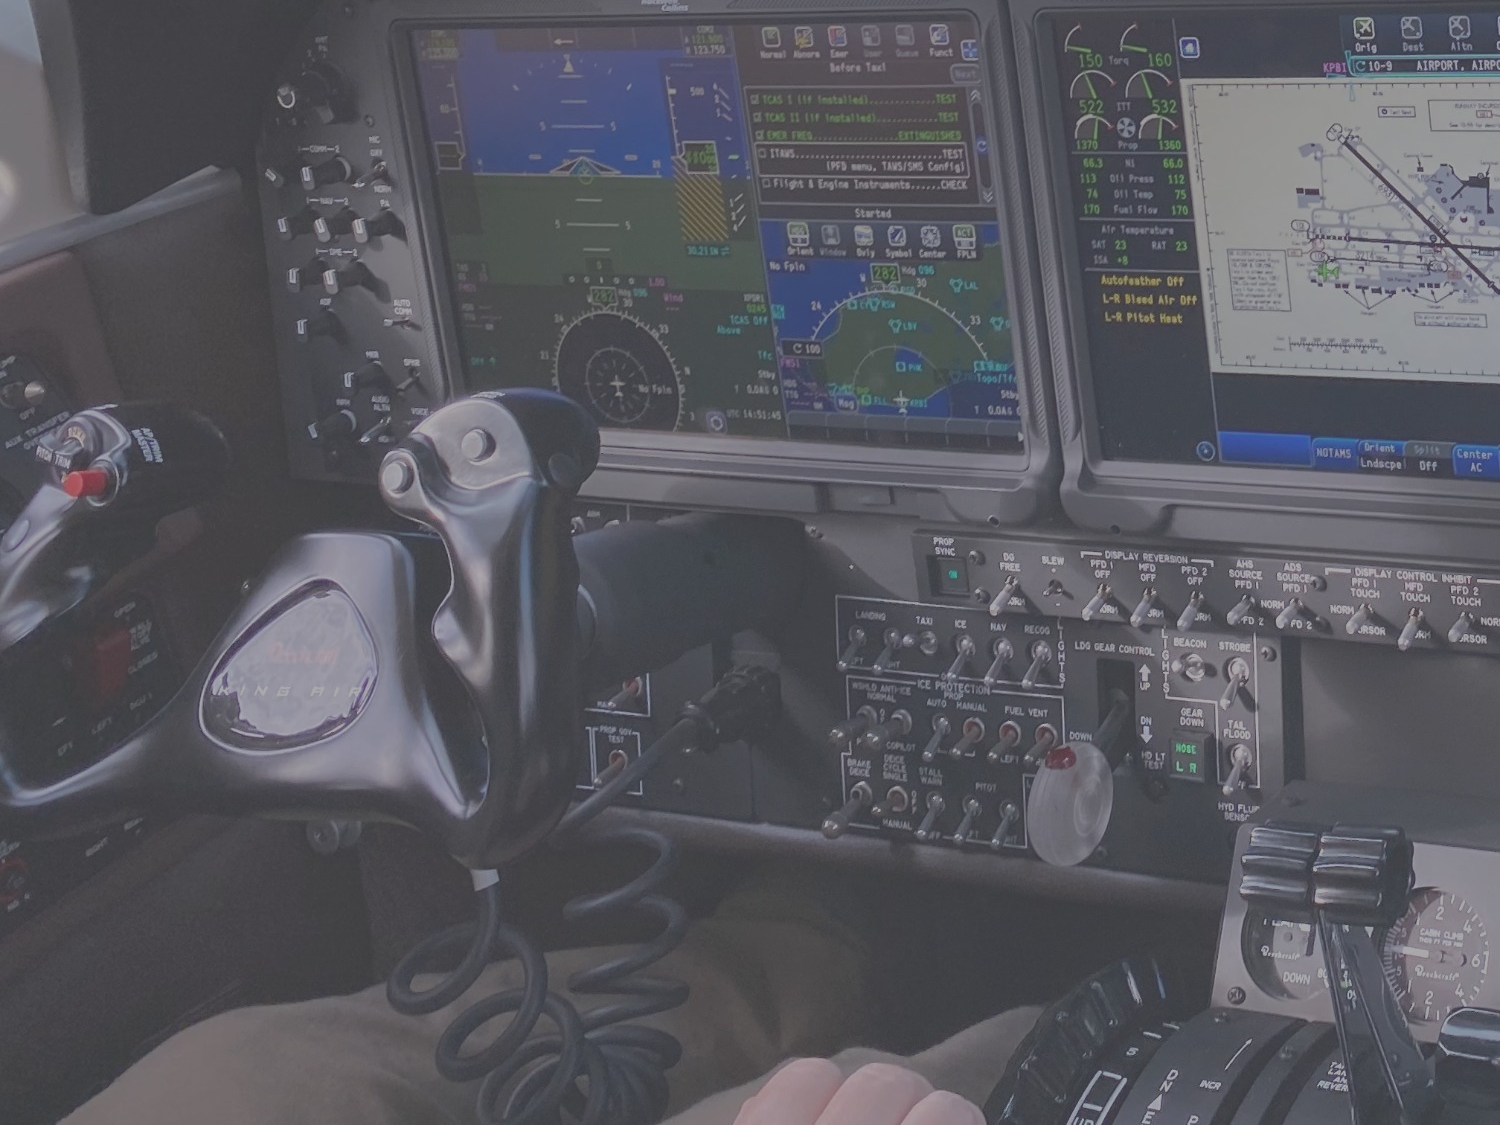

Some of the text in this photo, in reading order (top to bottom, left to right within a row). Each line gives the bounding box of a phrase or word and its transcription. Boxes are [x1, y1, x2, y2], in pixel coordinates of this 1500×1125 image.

[1355, 41, 1378, 53] Orig
[1079, 55, 1103, 68] 150
[1148, 54, 1172, 67] 160
[1368, 61, 1393, 71] 10-9
[1079, 100, 1104, 113] 522
[1152, 100, 1178, 113] 532
[854, 208, 892, 219] Started
[873, 267, 897, 279] 282
[1456, 449, 1493, 460] Center
[1470, 462, 1482, 472] AC
[1105, 550, 1188, 564] DISPLAY REVERSION
[1354, 568, 1472, 585] DISPLAY CONTROL INHIBIT
[1351, 588, 1380, 598] TOUCH
[1400, 592, 1430, 602] TOUCH
[855, 611, 886, 621] LANDING
[916, 616, 933, 625] TAXI
[1024, 625, 1050, 635] RECOG
[1075, 642, 1155, 656] LDG GEAR CONTROL
[1139, 682, 1150, 691] UP
[1004, 706, 1048, 718] FUEL VENT
[1179, 716, 1204, 727] DOWN
[1069, 731, 1092, 741] DOWN
[1223, 729, 1251, 740] FLOOD
[1283, 971, 1311, 985] DOWN
[1199, 1079, 1222, 1090] INCR
